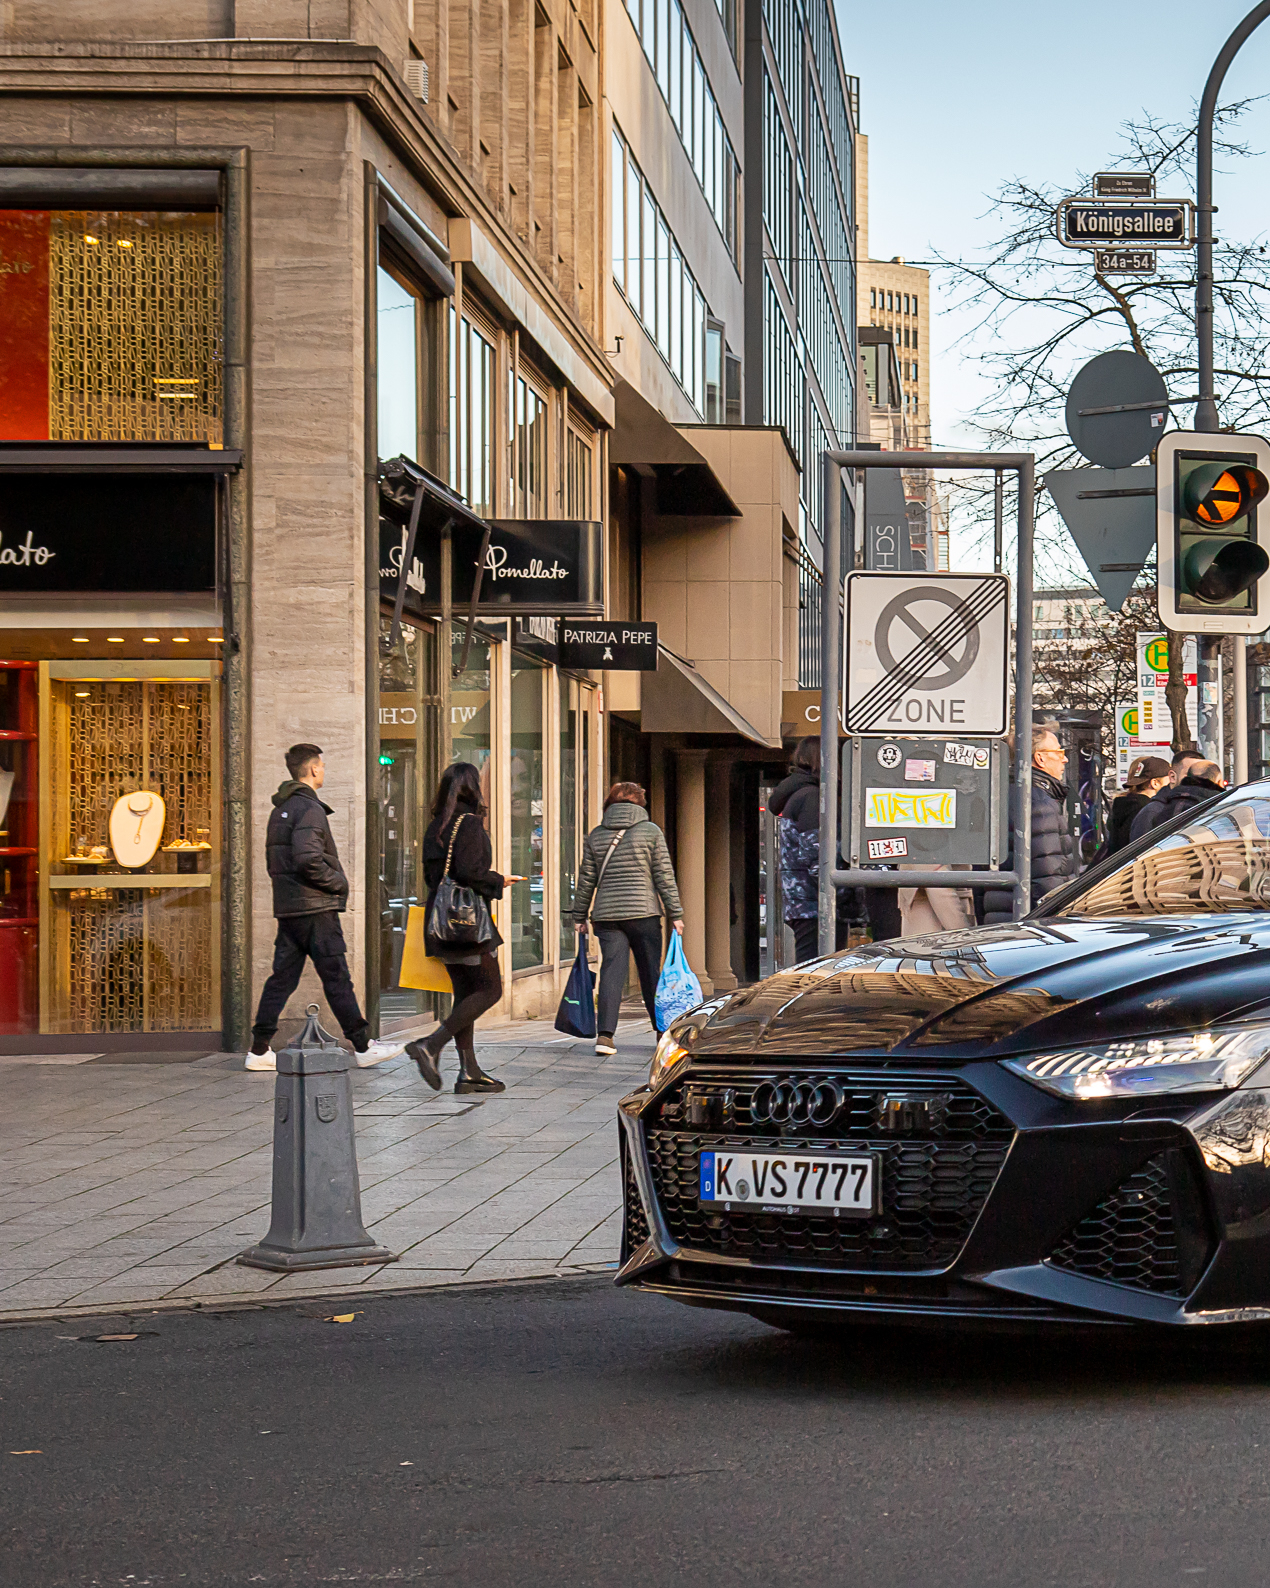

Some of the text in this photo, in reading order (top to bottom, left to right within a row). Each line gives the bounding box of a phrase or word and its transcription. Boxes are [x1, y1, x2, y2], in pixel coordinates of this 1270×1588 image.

[1076, 211, 1174, 236] Königsallee
[1102, 254, 1149, 269] 34a-54
[474, 544, 569, 581] Pomellato
[564, 629, 618, 644] PATRIZIA
[622, 630, 652, 645] PEPE
[1141, 675, 1154, 686] 12
[887, 699, 965, 723] ZONE
[1119, 737, 1128, 747] 12
[716, 1158, 733, 1195] K
[705, 1181, 711, 1192] D
